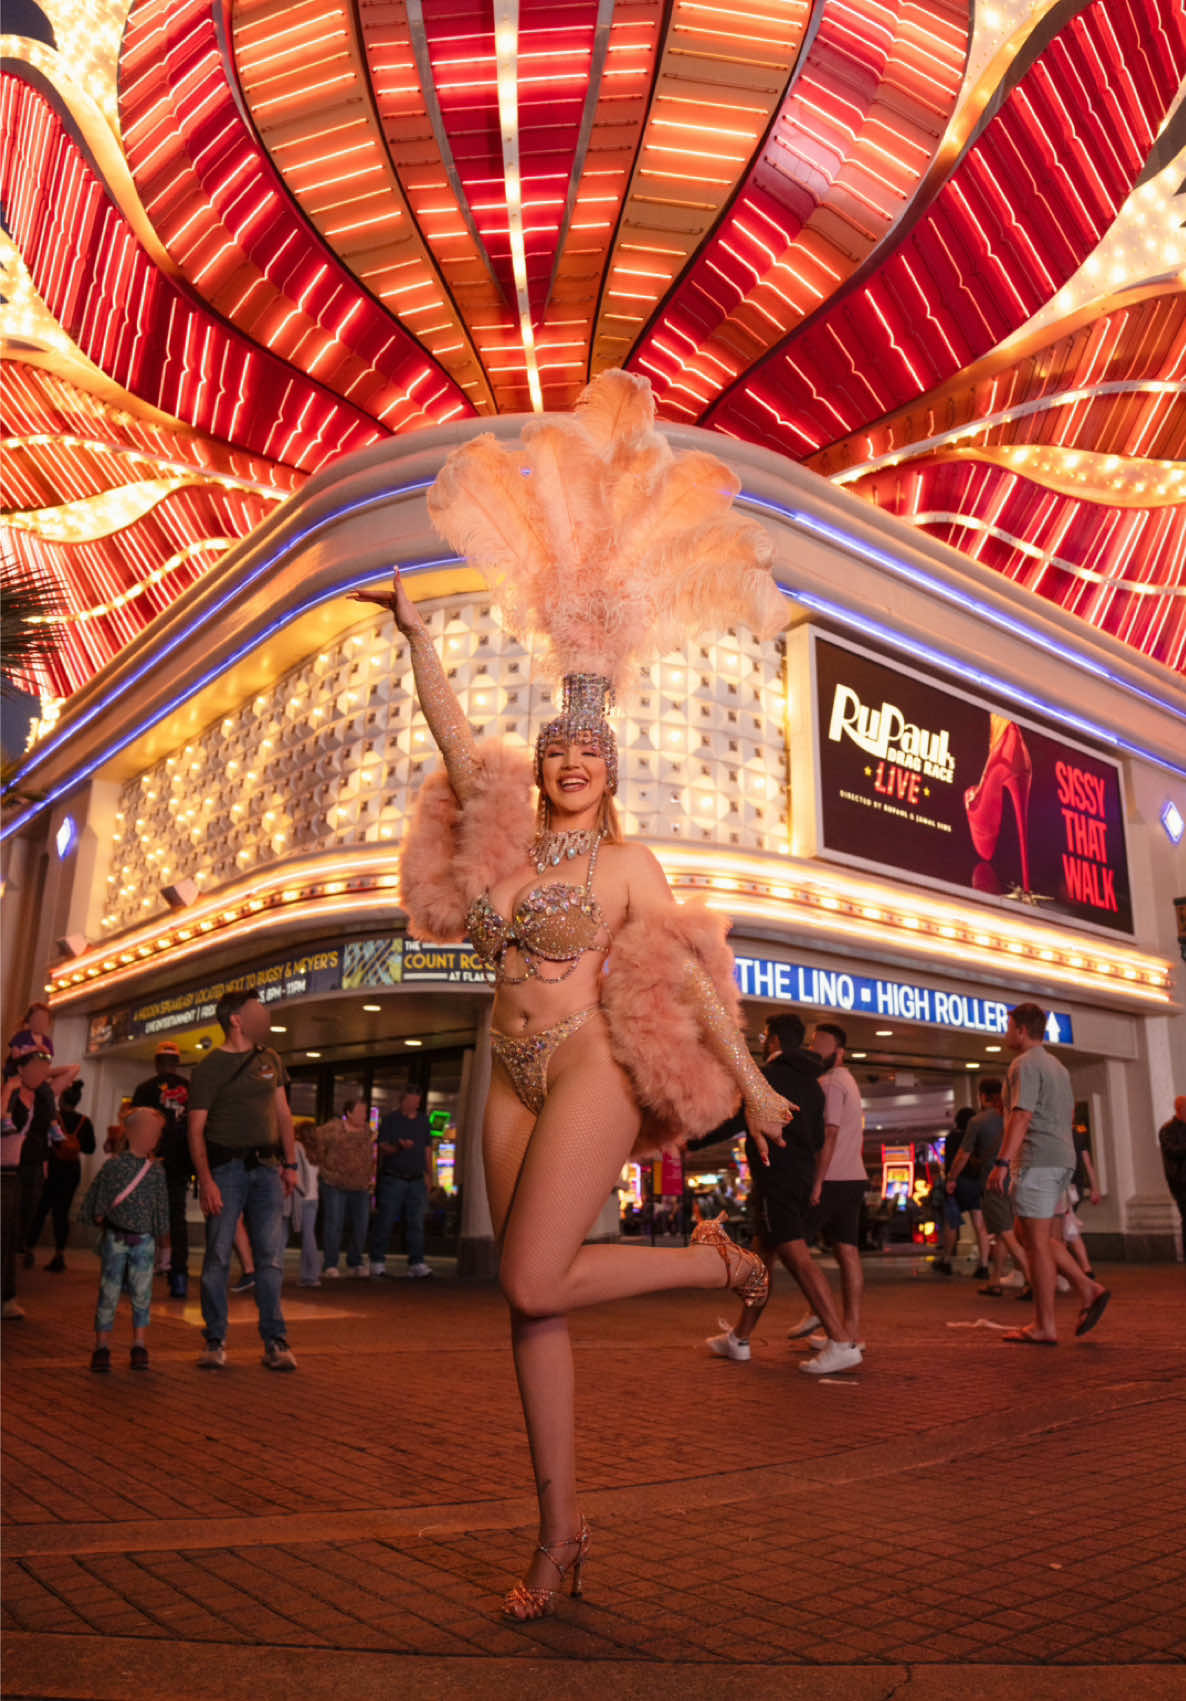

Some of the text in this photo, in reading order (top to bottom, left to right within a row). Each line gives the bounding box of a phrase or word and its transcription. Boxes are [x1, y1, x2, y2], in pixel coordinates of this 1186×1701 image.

[874, 761, 922, 804] LIVE
[887, 747, 954, 784] DRAG RACE
[1055, 760, 1105, 818] SISSY
[1061, 808, 1108, 863] THAT
[1062, 854, 1118, 912] WALK
[403, 953, 495, 970] COUNT RO
[405, 941, 420, 952] THE
[449, 971, 460, 981] AT
[735, 957, 1009, 1033] THE LINQ HIGH ROLLER
